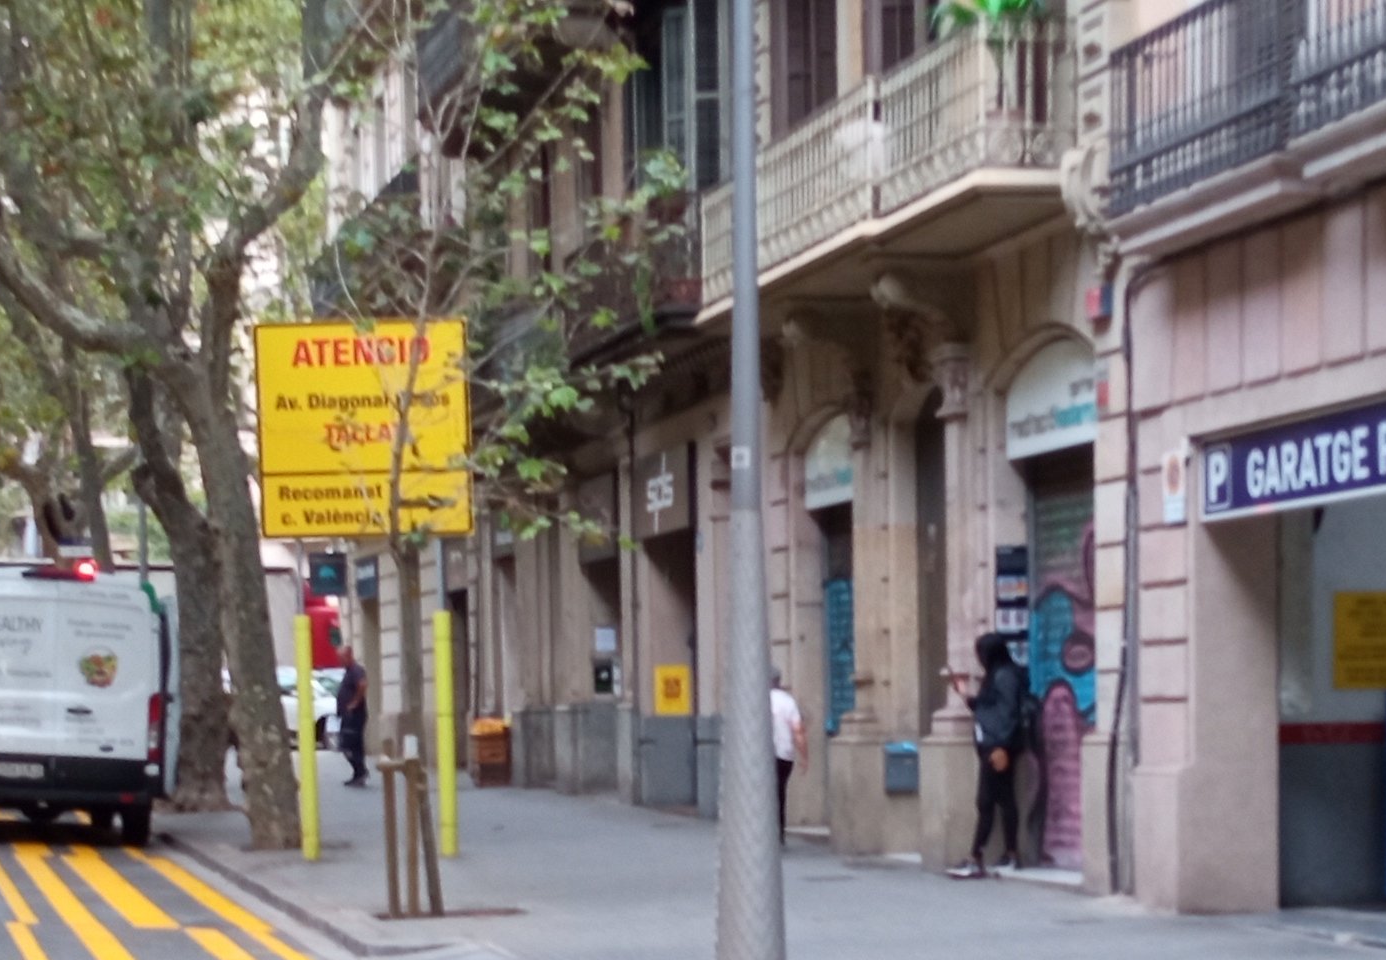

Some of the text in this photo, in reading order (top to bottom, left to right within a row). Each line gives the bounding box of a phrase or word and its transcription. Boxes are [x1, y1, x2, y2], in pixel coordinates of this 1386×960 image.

[276, 393, 302, 411] Av.
[307, 391, 388, 412] Diagonal
[1208, 451, 1228, 503] P
[1246, 426, 1370, 499] GARATGE
[278, 483, 382, 500] Recomanat
[281, 512, 297, 526] c.
